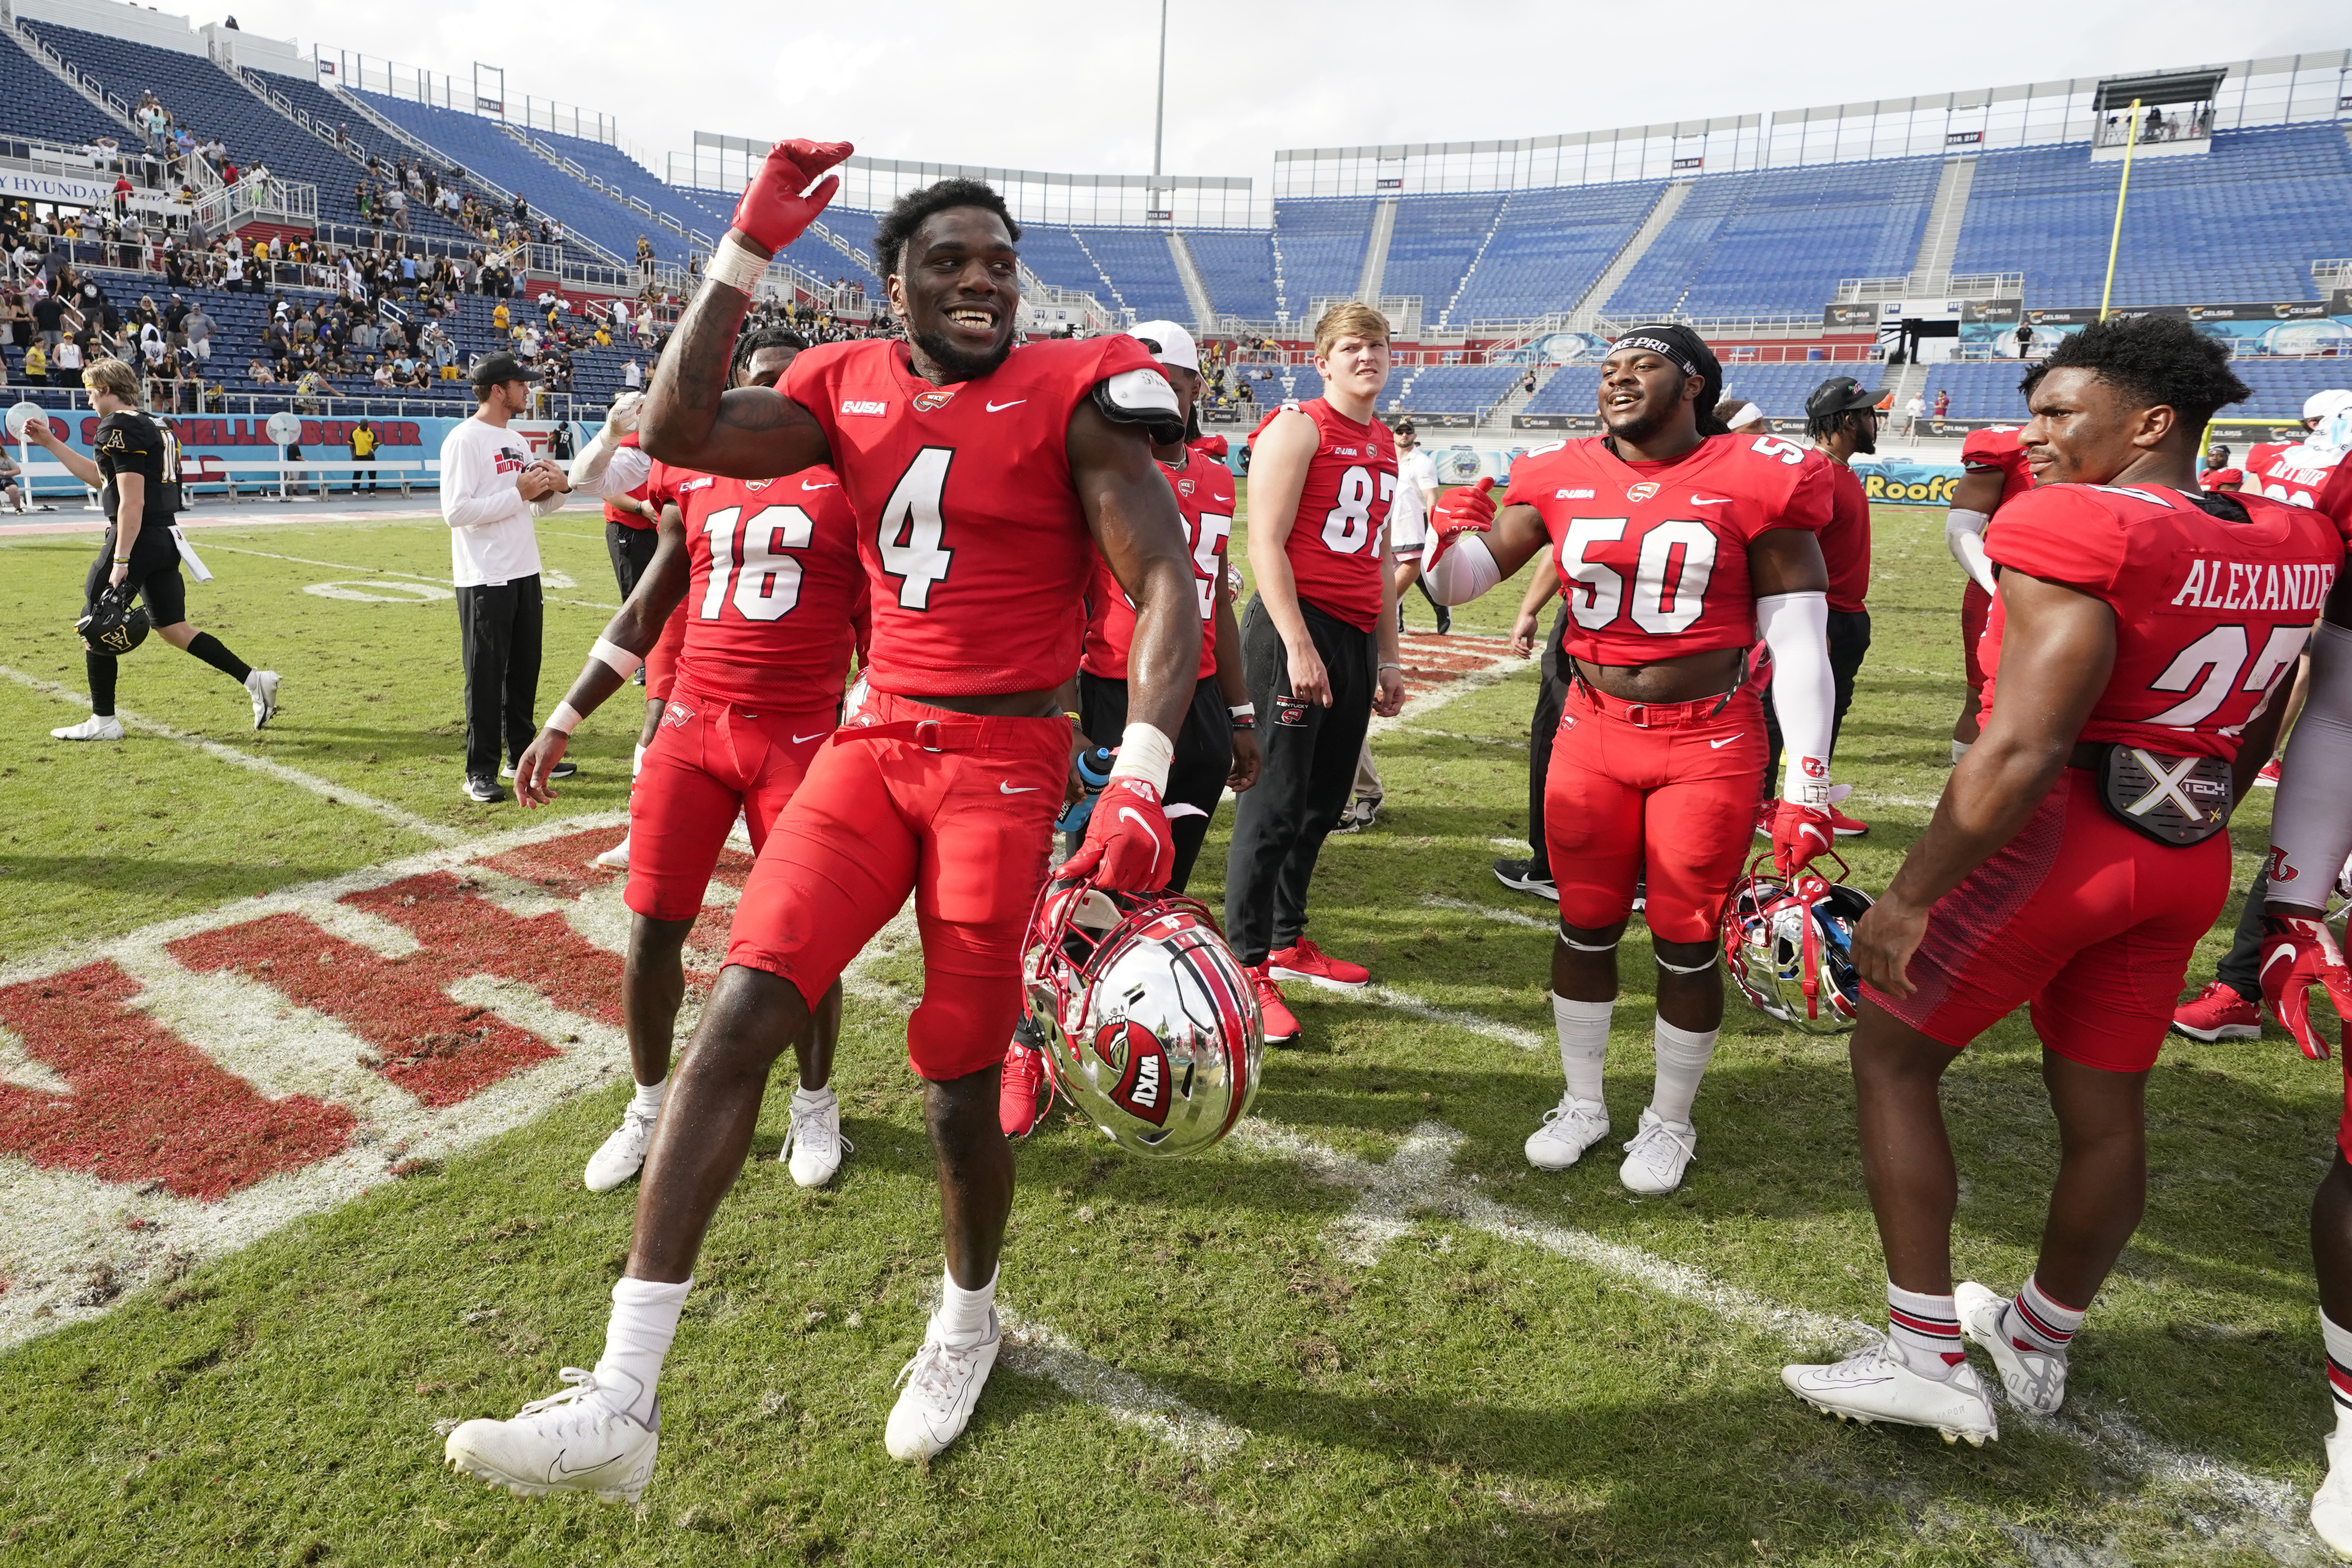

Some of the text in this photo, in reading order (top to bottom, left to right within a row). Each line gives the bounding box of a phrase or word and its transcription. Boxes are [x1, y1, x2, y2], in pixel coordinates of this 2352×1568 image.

[14, 176, 107, 201] HYUNDAI
[1635, 337, 1671, 354] PRO
[560, 434, 569, 444] 19
[1865, 474, 1960, 502] RoofC
[2266, 461, 2327, 486] ARTHUR
[877, 445, 955, 612] 4
[1320, 465, 1398, 559] 87
[700, 504, 815, 622] 16
[1170, 511, 1232, 620] 5
[1560, 517, 1718, 635] 50
[2171, 559, 2335, 611] ALEXANDE
[2140, 623, 2313, 737] 27
[1131, 1055, 1159, 1108] WKU
